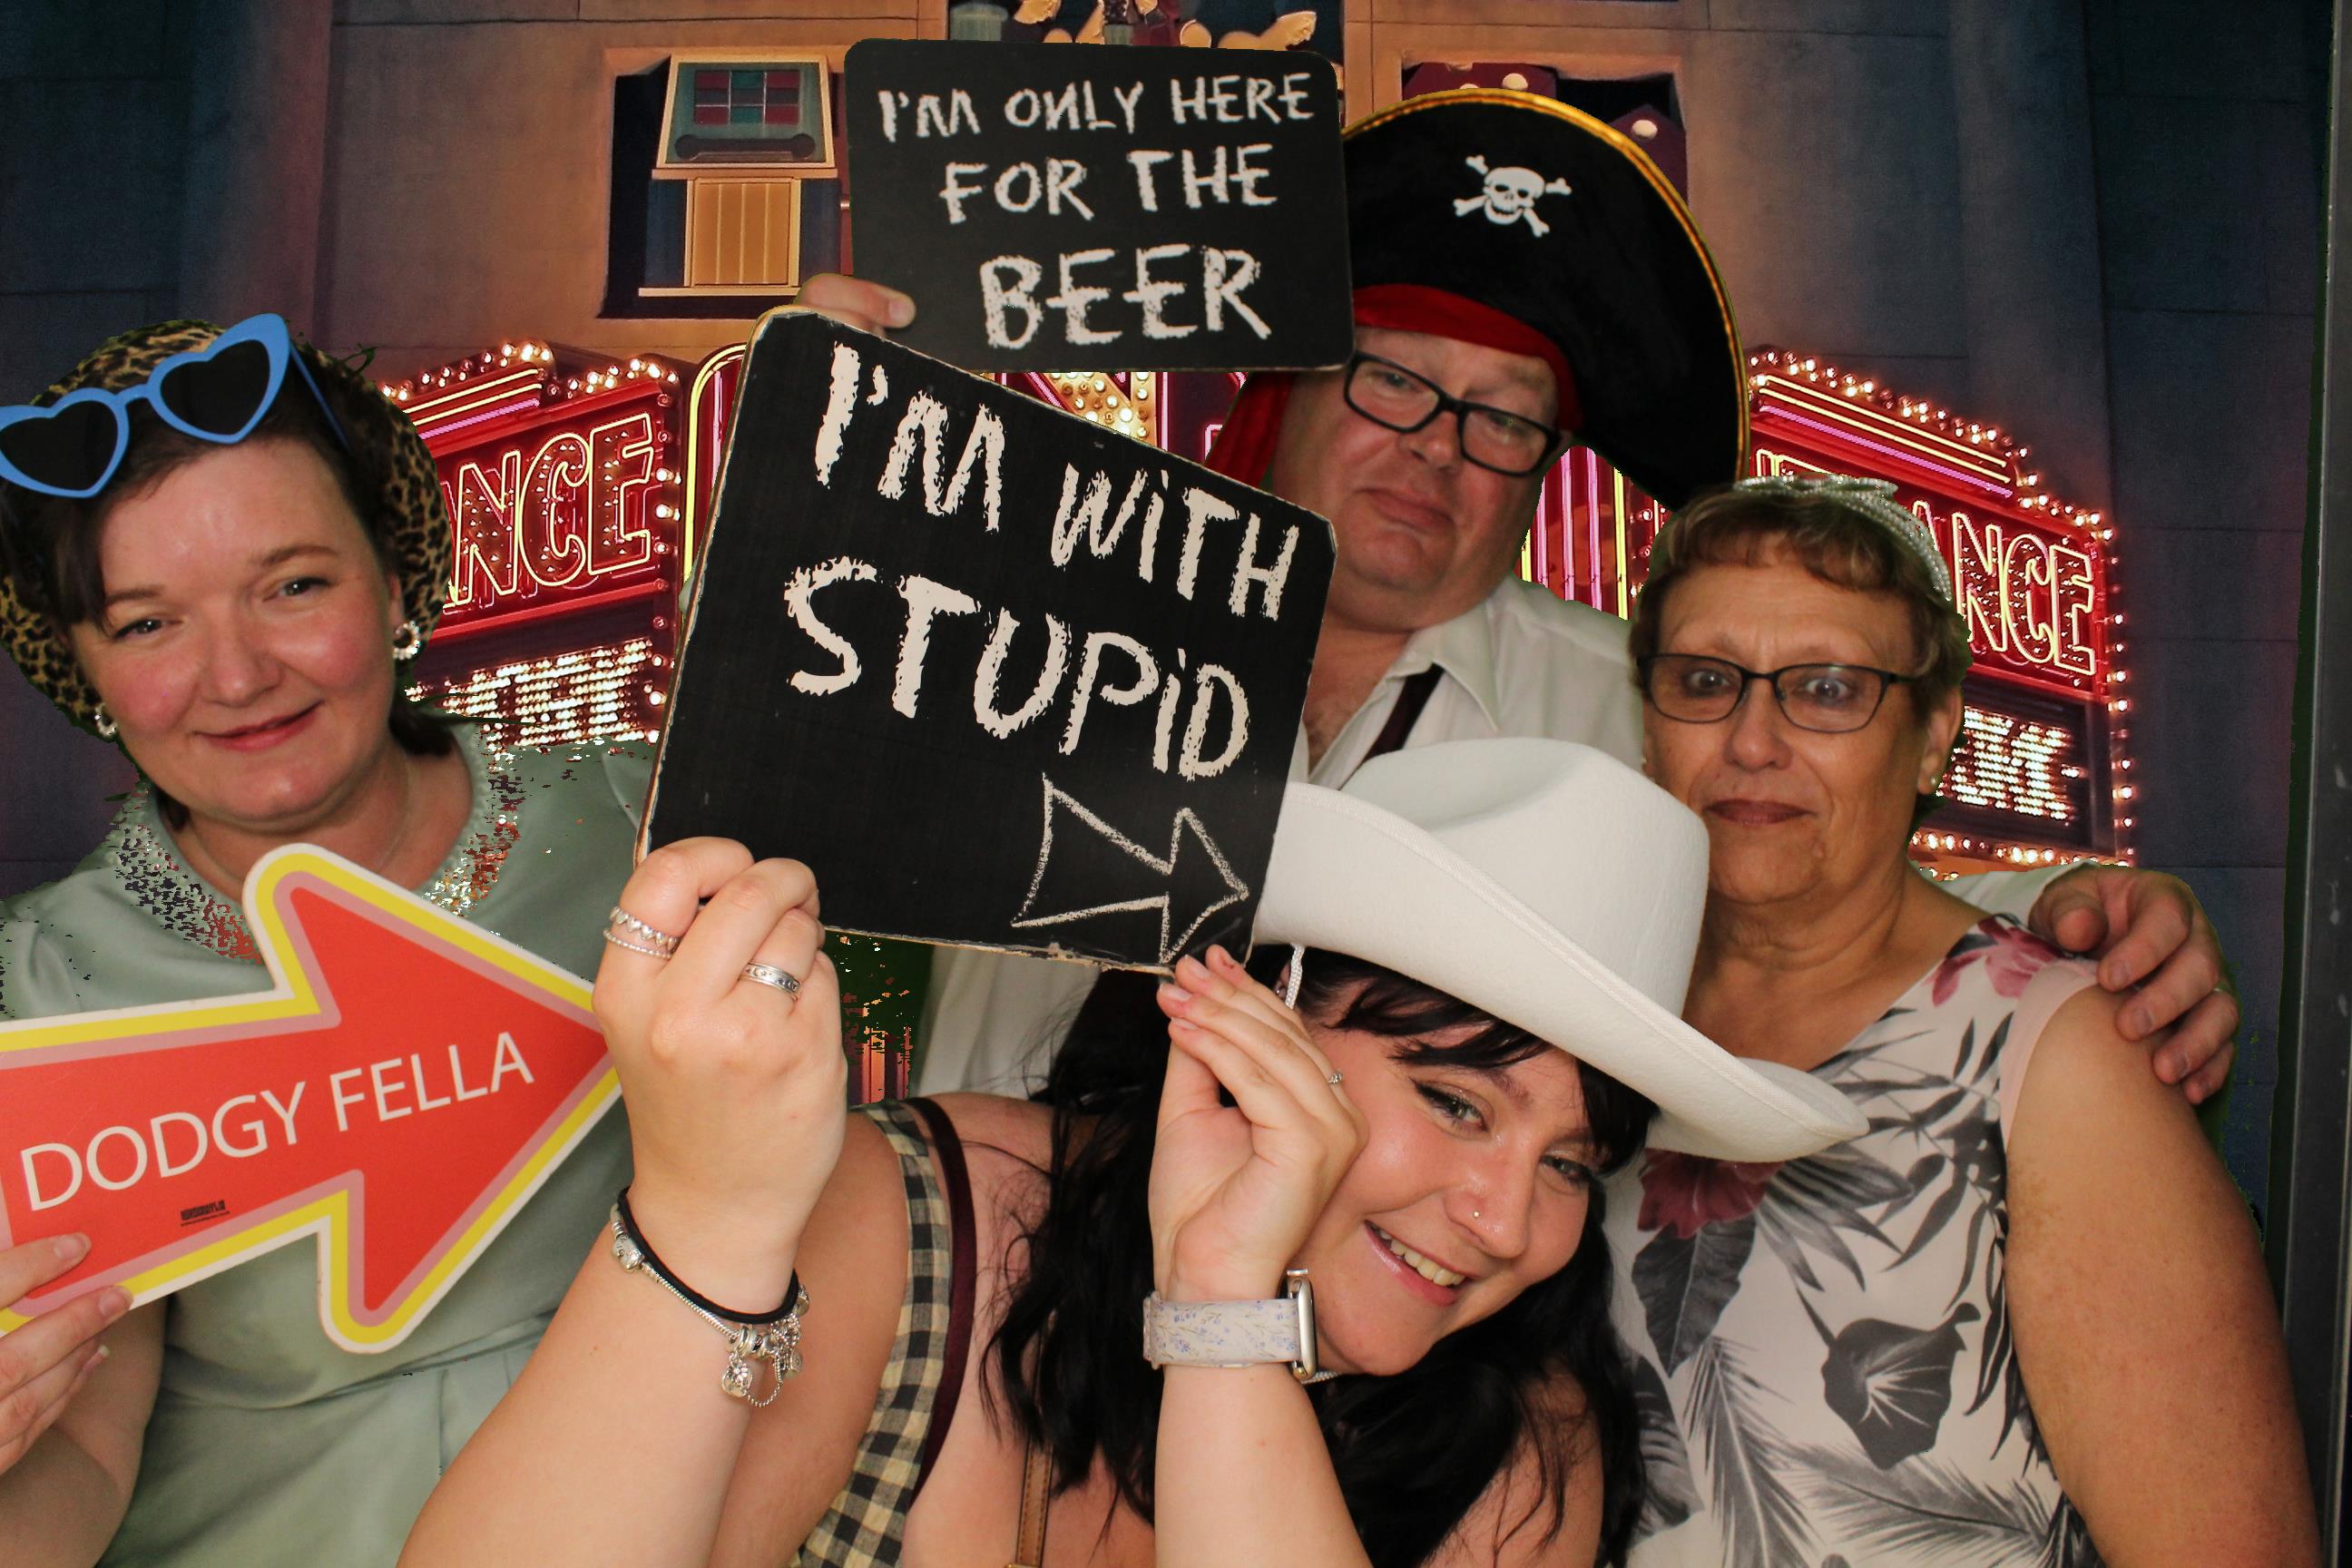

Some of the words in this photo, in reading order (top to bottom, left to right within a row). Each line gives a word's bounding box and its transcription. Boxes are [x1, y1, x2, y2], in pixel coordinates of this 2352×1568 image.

[878, 89, 981, 142] I'M
[1004, 81, 1143, 133] ONLY
[1171, 74, 1314, 123] HERE
[939, 159, 1094, 224] FOR
[1127, 144, 1277, 211] THE
[979, 244, 1271, 349] BEER
[814, 340, 1007, 533] I'M
[20, 1081, 307, 1211] DODGY
[329, 1032, 534, 1132] FELLA
